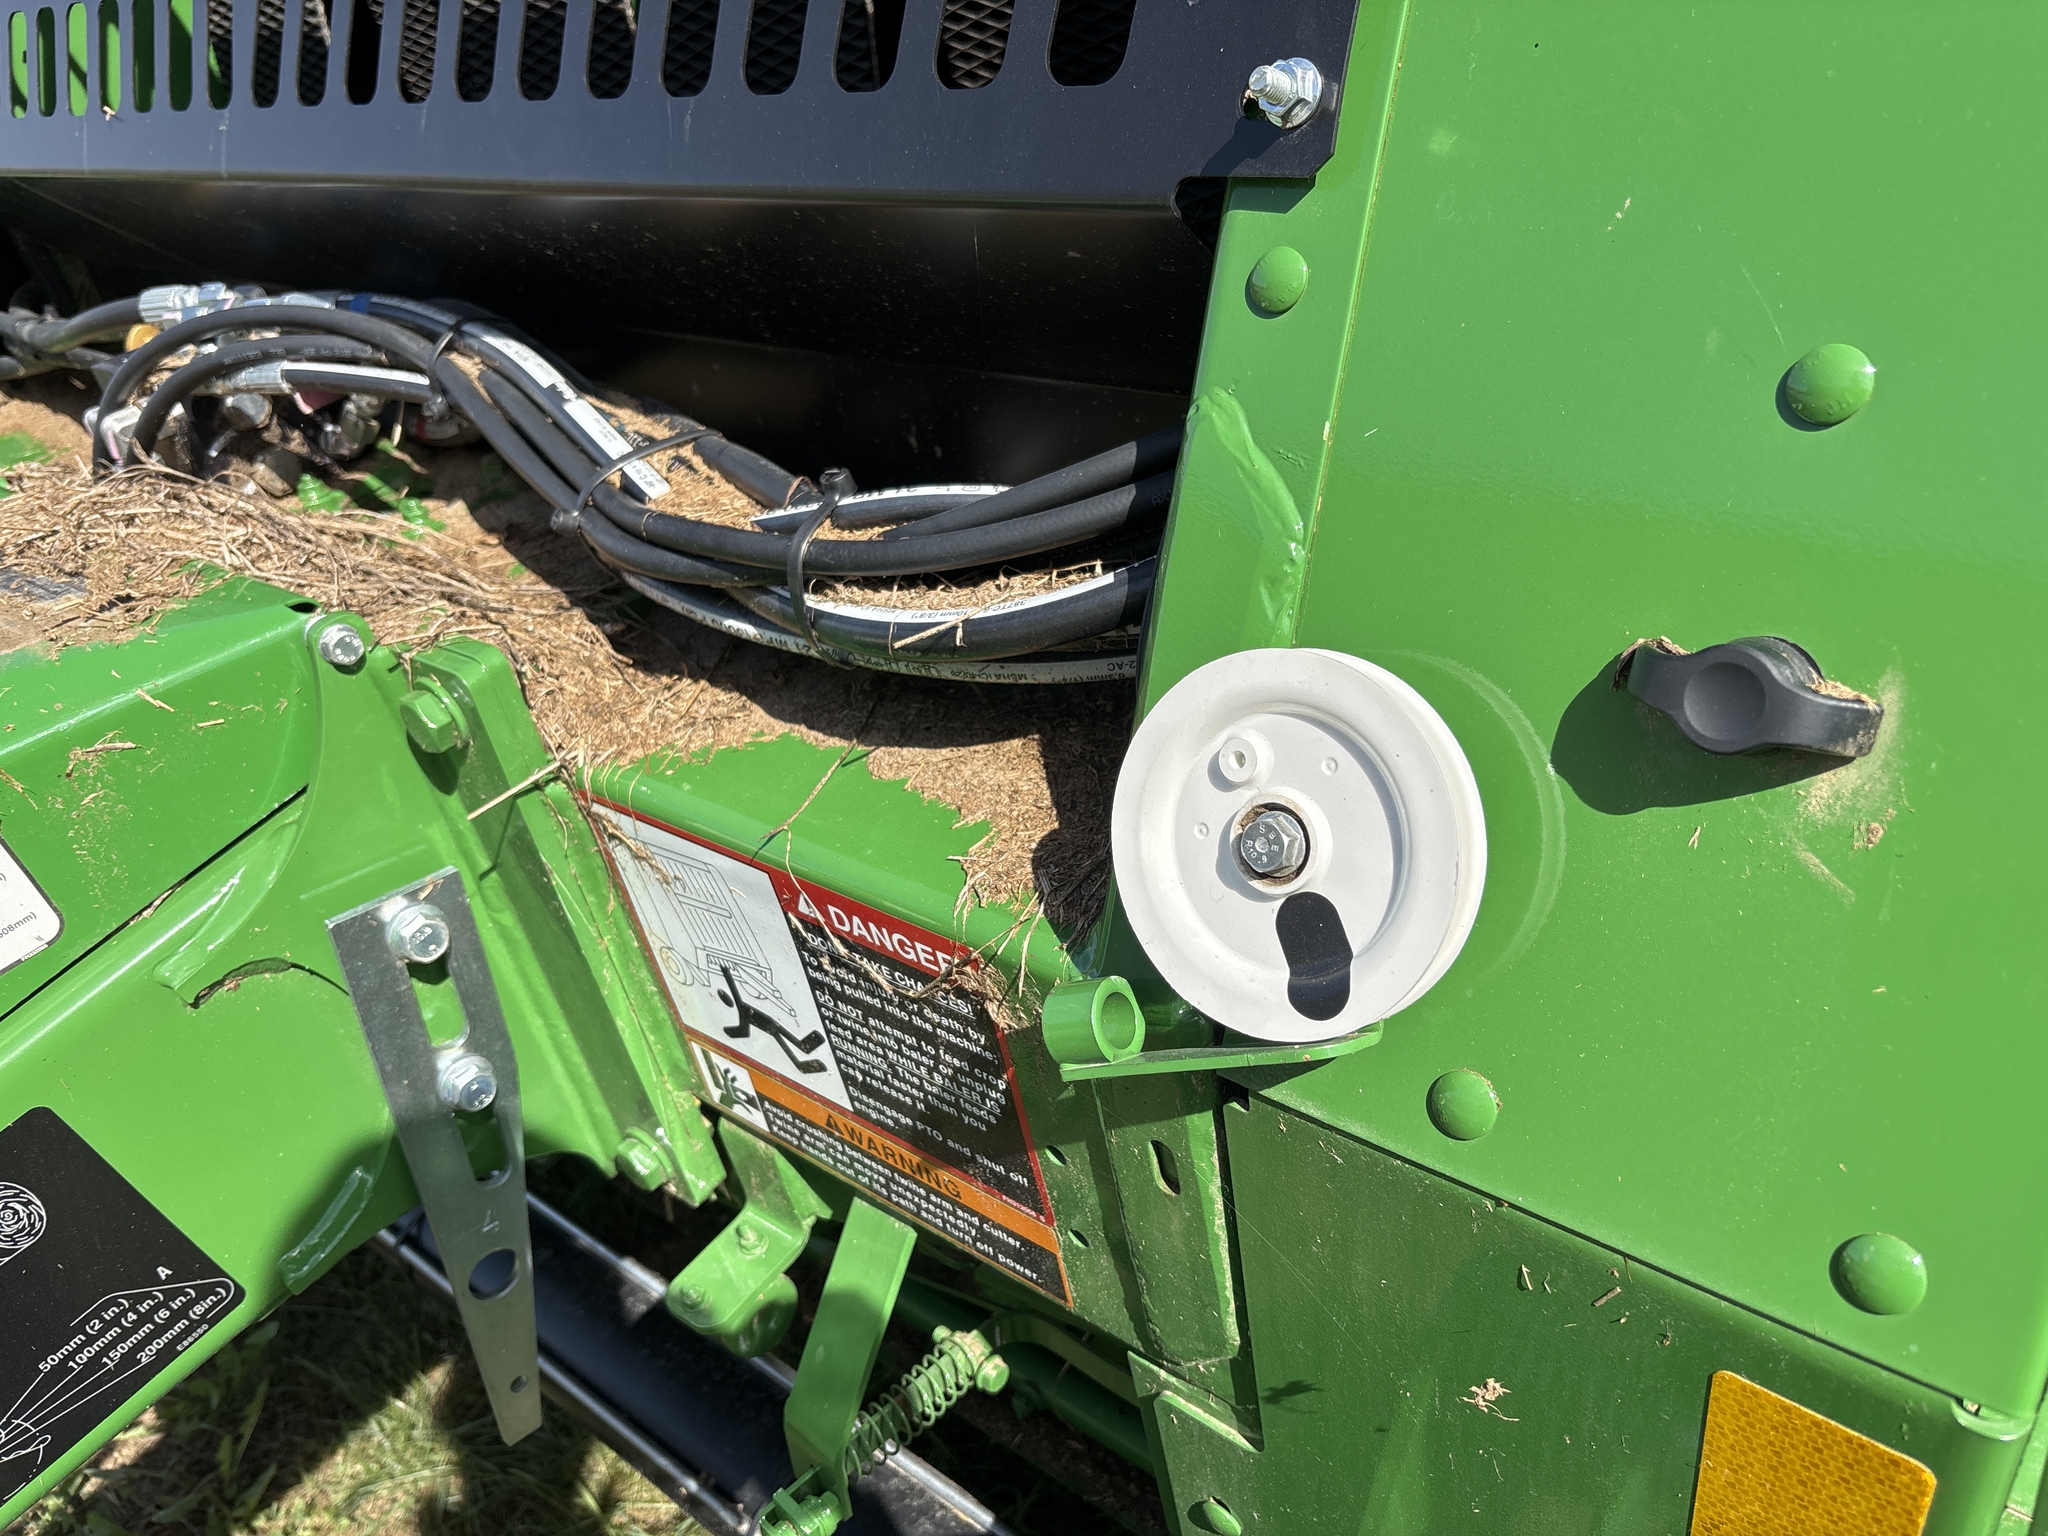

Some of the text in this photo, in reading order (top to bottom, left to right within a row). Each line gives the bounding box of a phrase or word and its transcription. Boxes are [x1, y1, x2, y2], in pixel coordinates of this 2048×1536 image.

[801, 950, 818, 966] To
[822, 962, 857, 984] void
[904, 1000, 918, 1011] or
[924, 1008, 964, 1033] death
[968, 1027, 985, 1044] by
[807, 966, 998, 1064] being pulled into the machine;
[894, 971, 975, 1017] CHACES!
[815, 989, 1006, 1090] DO NOT attempt to feed crop
[820, 1007, 833, 1018] or
[836, 1013, 870, 1036] twine
[874, 1031, 899, 1050] into
[901, 1044, 934, 1067] baler
[957, 1073, 1006, 1105] unplug
[825, 1020, 1001, 1114] feed area WHILE BALER IS
[829, 1033, 997, 1124] RUNNING. The baler feeds
[835, 1049, 987, 1131] material faster than you
[853, 1101, 900, 1129] engine.
[866, 1076, 913, 1105] release
[915, 1099, 931, 1114] it.
[763, 1100, 793, 1122] Avoid
[794, 1119, 843, 1152] crushing
[844, 1144, 892, 1178] between
[893, 1172, 927, 1196] twine
[929, 1193, 953, 1211] arm
[956, 1207, 980, 1226] and
[983, 1223, 1024, 1251] cutter.
[765, 1112, 800, 1136] Twine
[802, 1133, 825, 1150] arm
[829, 1148, 850, 1164] can
[853, 1161, 886, 1184] move
[889, 1181, 980, 1238] unexpectedly.
[842, 1122, 962, 1199] WARNING
[848, 1086, 1028, 1186] Disengage PTO and shut off
[771, 1124, 1042, 1282] Keep hands out of its path and turn off power.
[155, 1265, 173, 1281] A
[38, 1298, 130, 1373] 50mm (2 in.)
[67, 1291, 164, 1370] 100mm (4 in.)
[101, 1287, 196, 1367] 150mm (6 in.)
[136, 1287, 227, 1364] 200mm (8in.)
